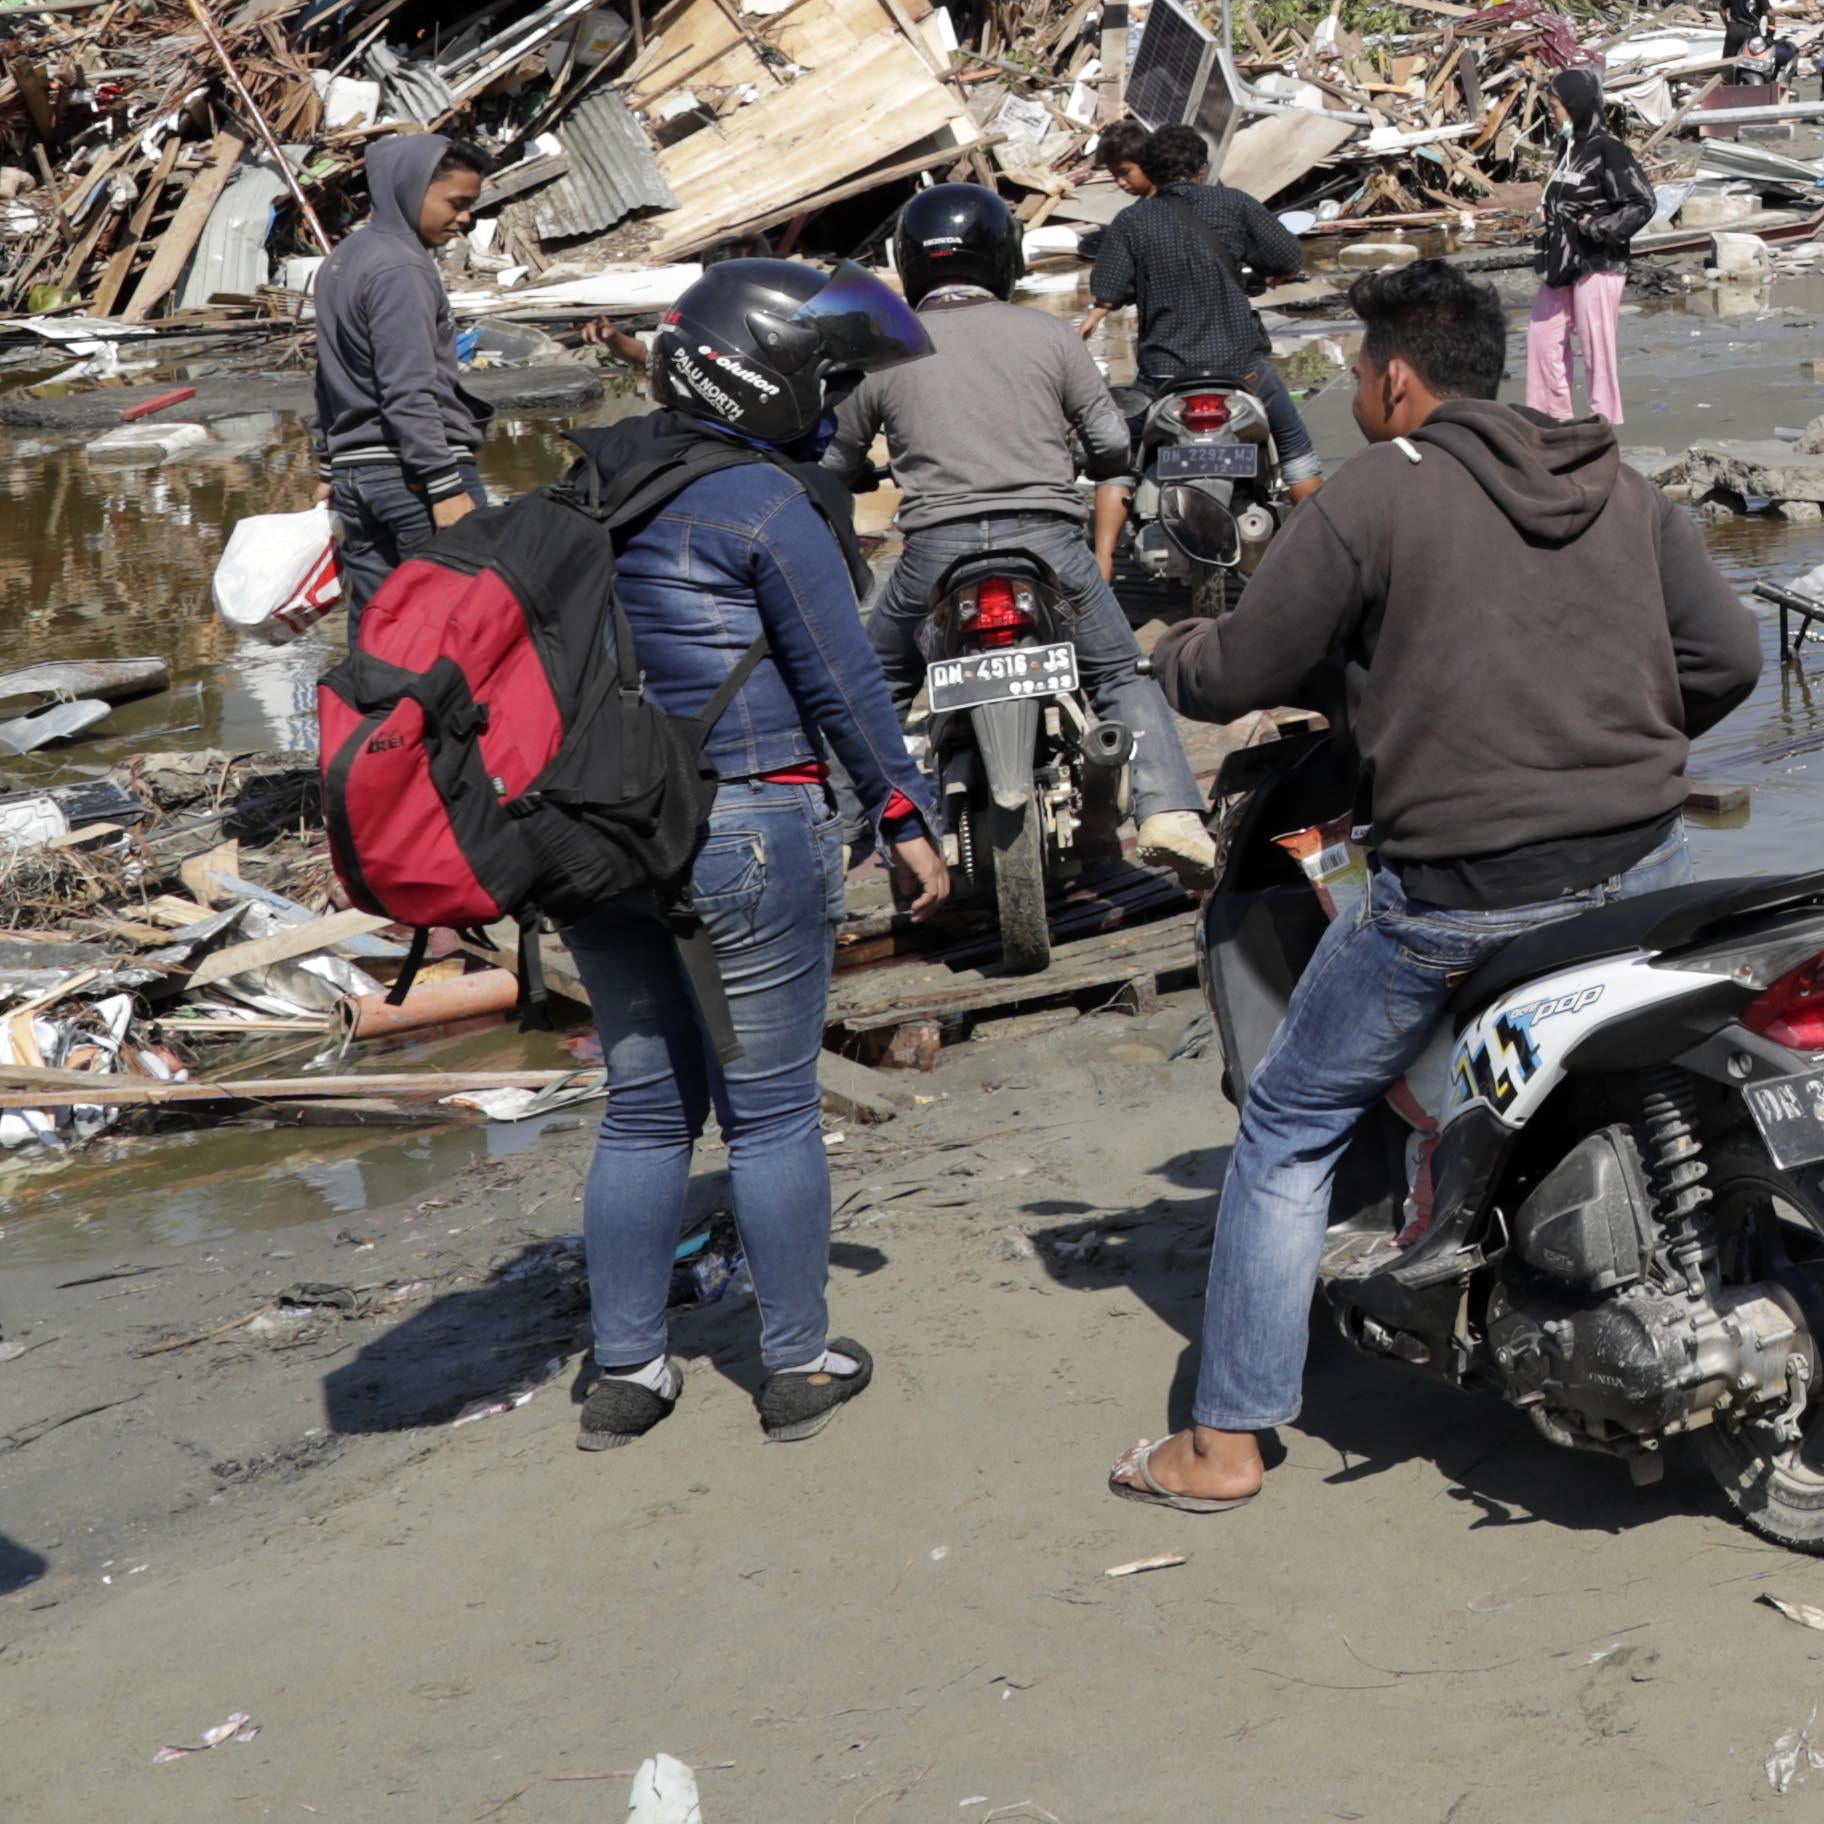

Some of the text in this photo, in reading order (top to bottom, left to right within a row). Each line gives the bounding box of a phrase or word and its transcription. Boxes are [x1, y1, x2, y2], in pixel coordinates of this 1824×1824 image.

[673, 347, 745, 419] PALU NORTH
[697, 344, 780, 396] evolution
[934, 648, 1071, 687] DN 4516 JS
[1530, 984, 1605, 1027] pop
